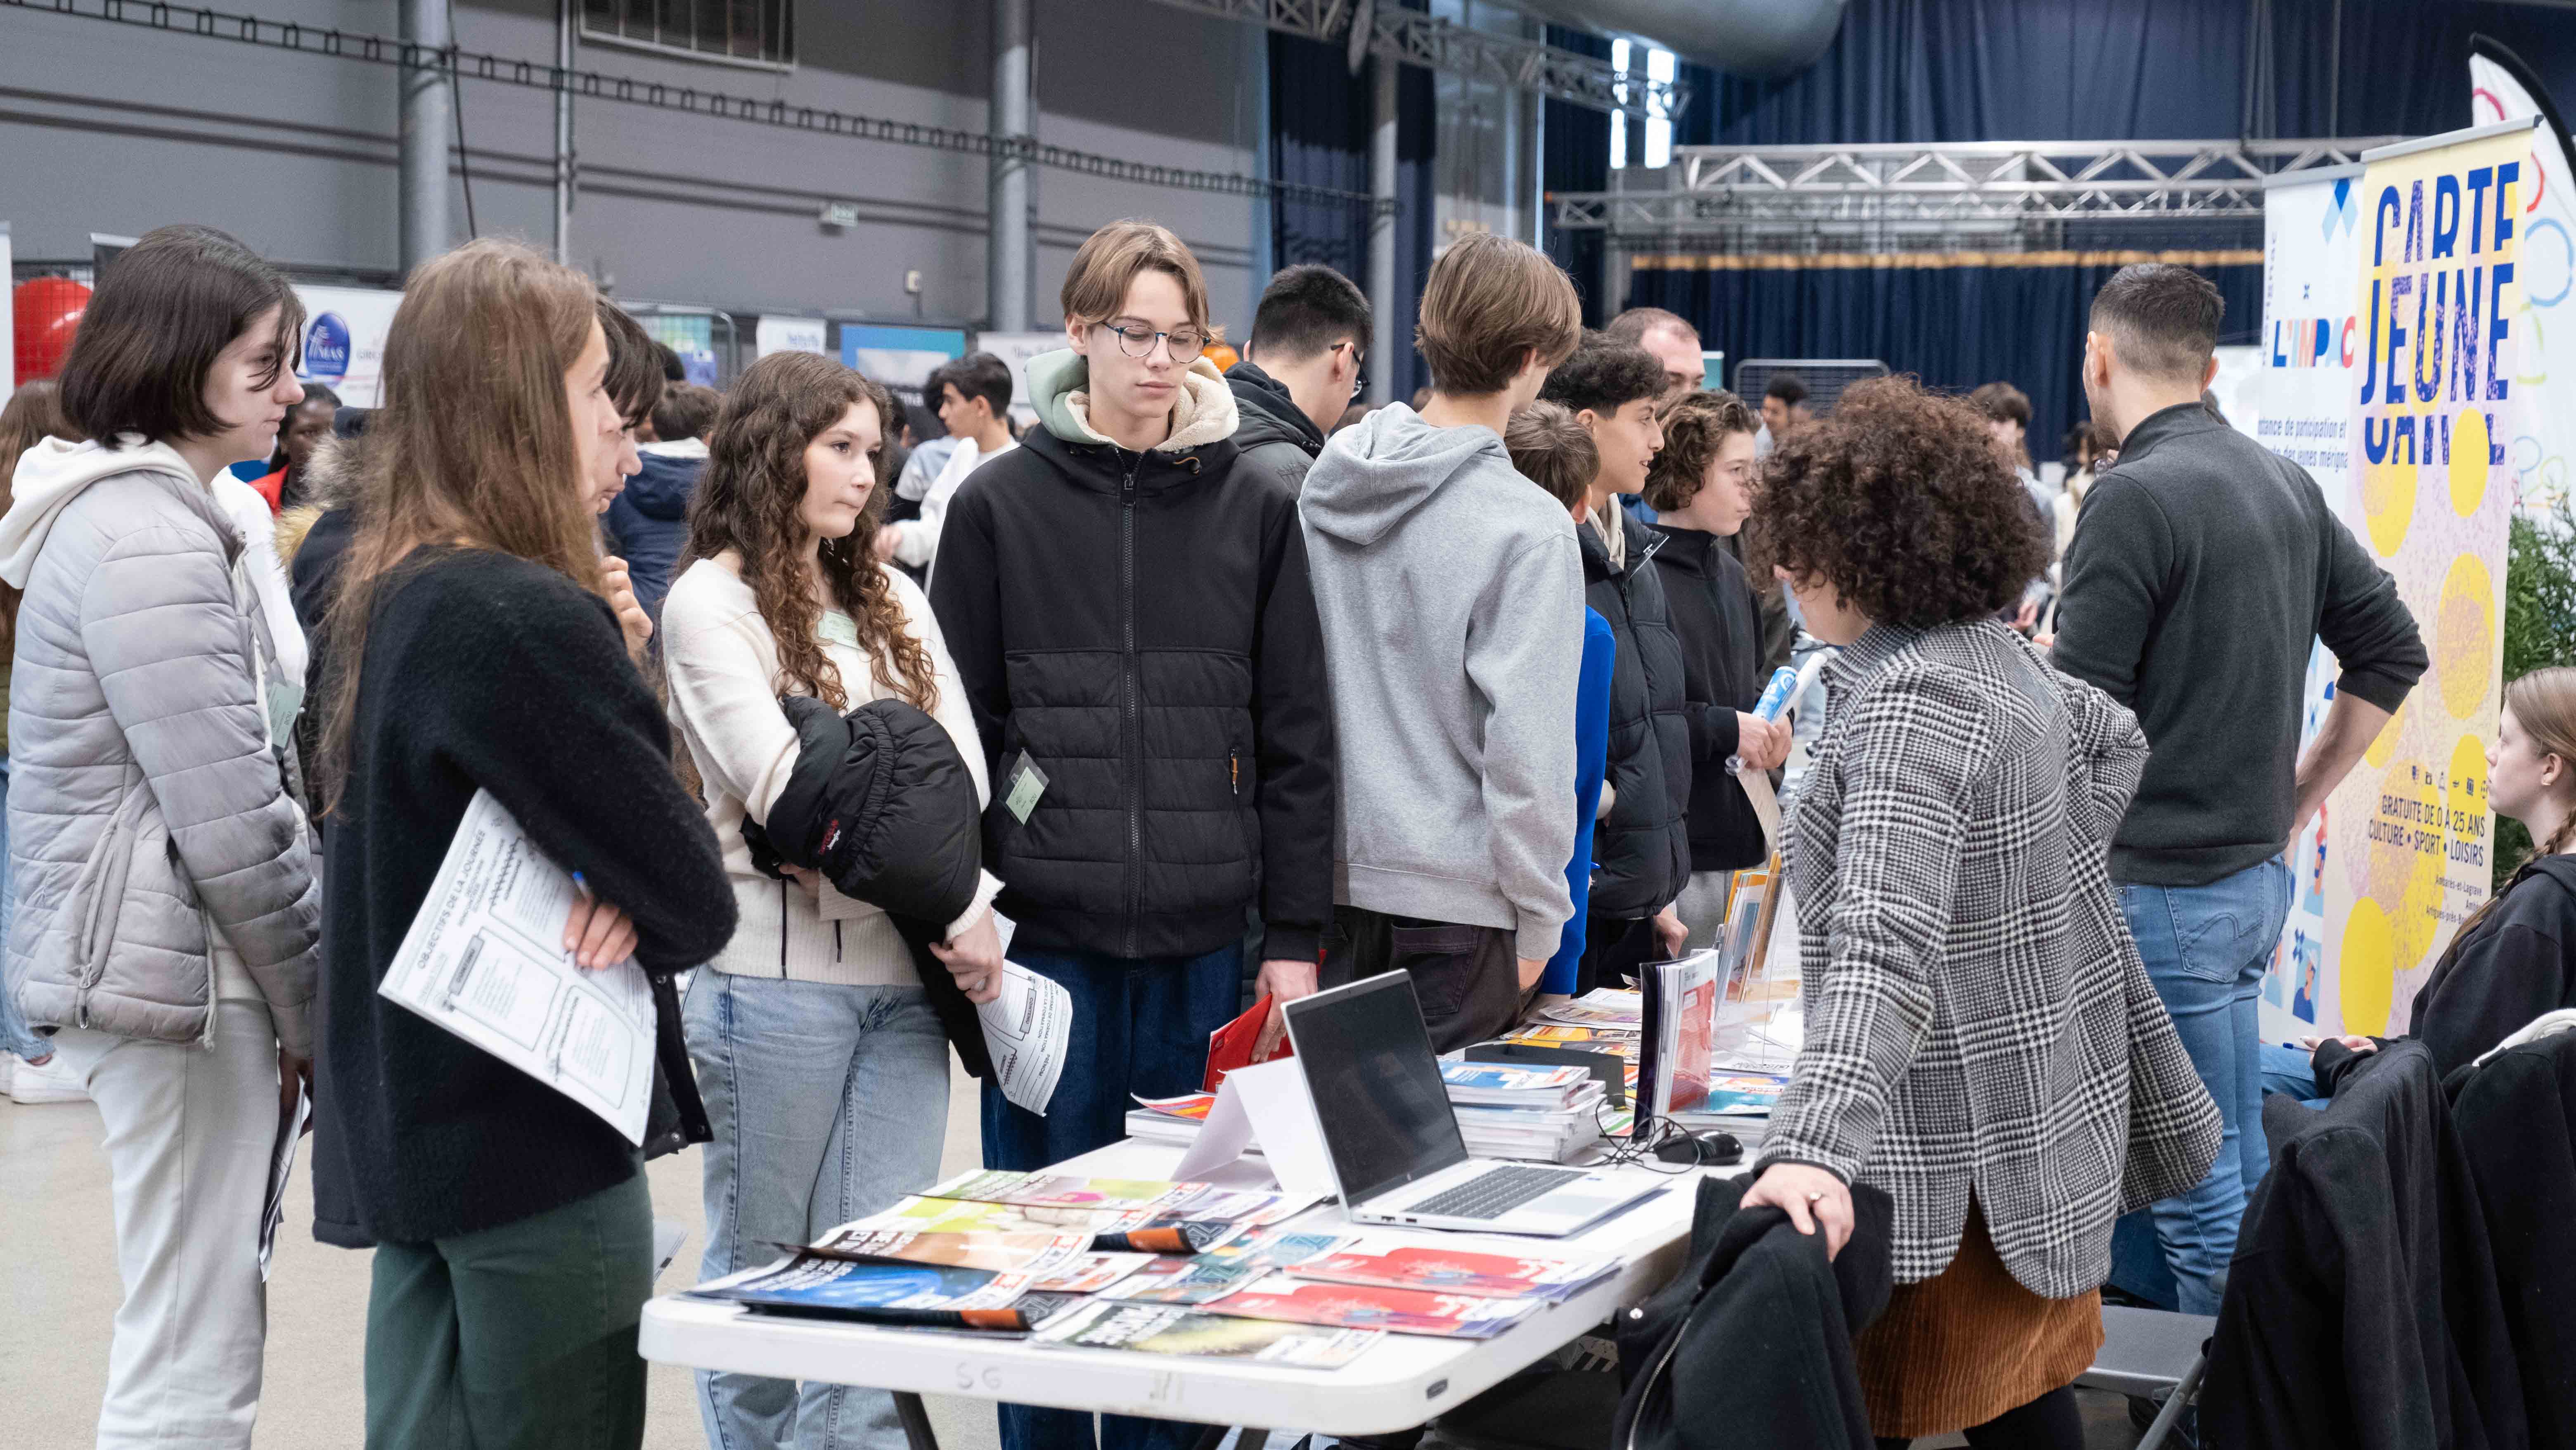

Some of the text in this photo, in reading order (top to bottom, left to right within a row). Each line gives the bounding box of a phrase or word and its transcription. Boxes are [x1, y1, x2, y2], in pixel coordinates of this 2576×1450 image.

[2374, 161, 2519, 266] CARTE
[2361, 263, 2514, 405] JEUNE
[2295, 417, 2337, 441] participation
[2339, 418, 2347, 438] et
[2382, 794, 2422, 823] GRATUITE
[2424, 803, 2434, 825] DE
[2445, 803, 2450, 829] À
[2453, 810, 2465, 833] 25
[2467, 813, 2485, 837] ANS
[2368, 819, 2484, 867] CULTURE SPORT LOISIRS
[415, 909, 452, 971] OBJECTIFS
[445, 893, 459, 910] DE
[452, 877, 466, 894] LA
[459, 828, 487, 879] JOURNÉE
[1025, 997, 1034, 1024] CONTENU
[1037, 1006, 1046, 1039] FORMATION
[1040, 1019, 1051, 1052] FORMATION
[1038, 1054, 1051, 1077] PRÉNOM
